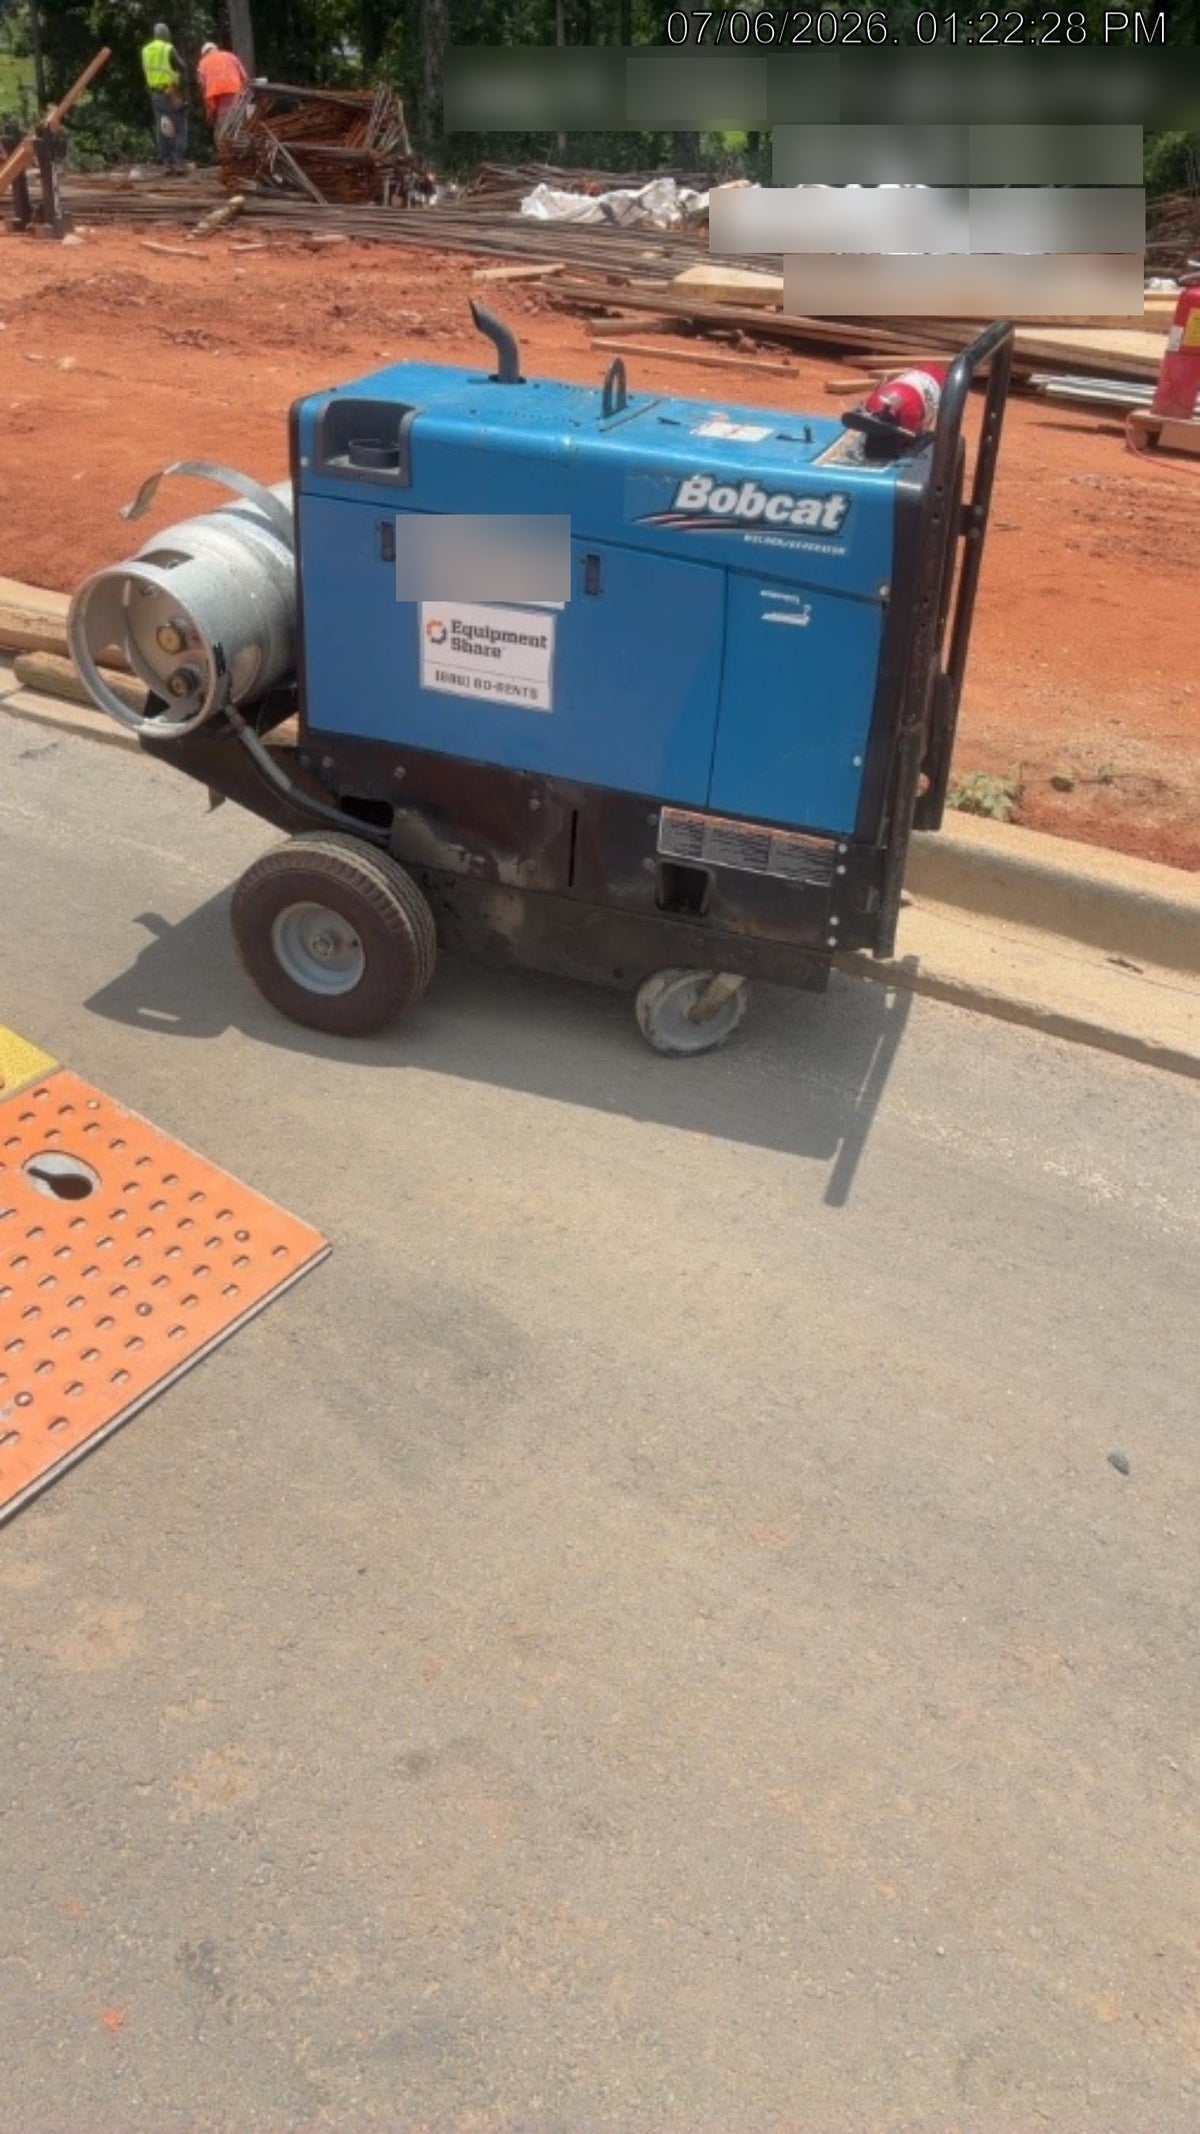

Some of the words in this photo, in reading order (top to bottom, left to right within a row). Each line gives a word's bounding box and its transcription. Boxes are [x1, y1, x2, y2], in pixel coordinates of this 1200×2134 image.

[672, 474, 851, 533] Bobcat
[450, 618, 549, 649] Equipment
[450, 637, 502, 659] Share
